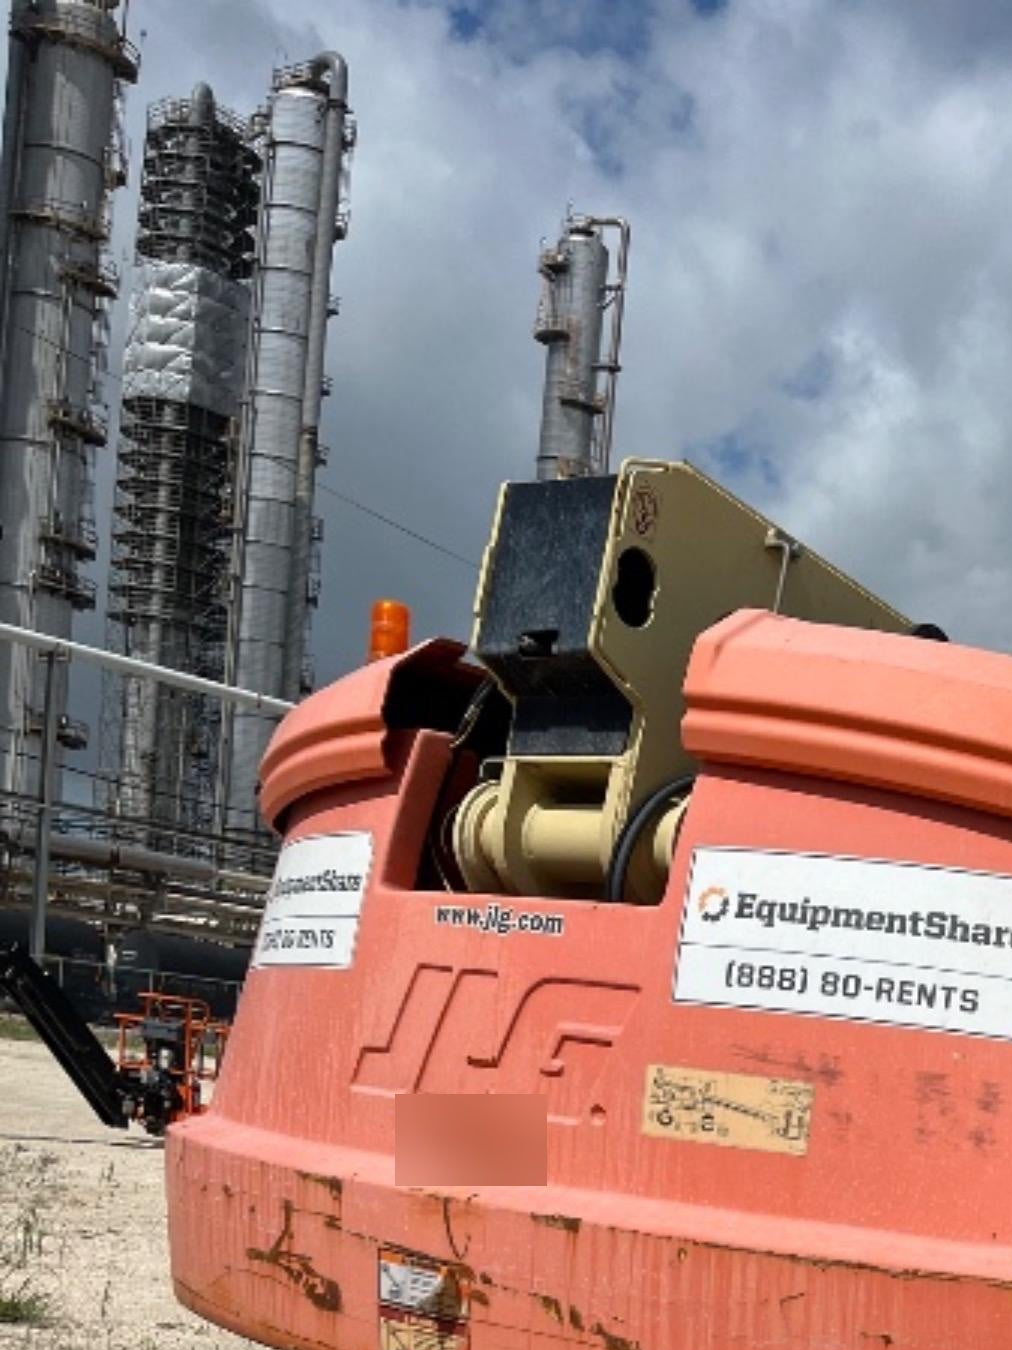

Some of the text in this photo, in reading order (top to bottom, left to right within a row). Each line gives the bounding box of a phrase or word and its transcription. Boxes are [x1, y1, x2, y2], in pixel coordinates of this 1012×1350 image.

[436, 905, 564, 934] www.jlg.com
[725, 959, 981, 1014] (888) 80-RENTS
